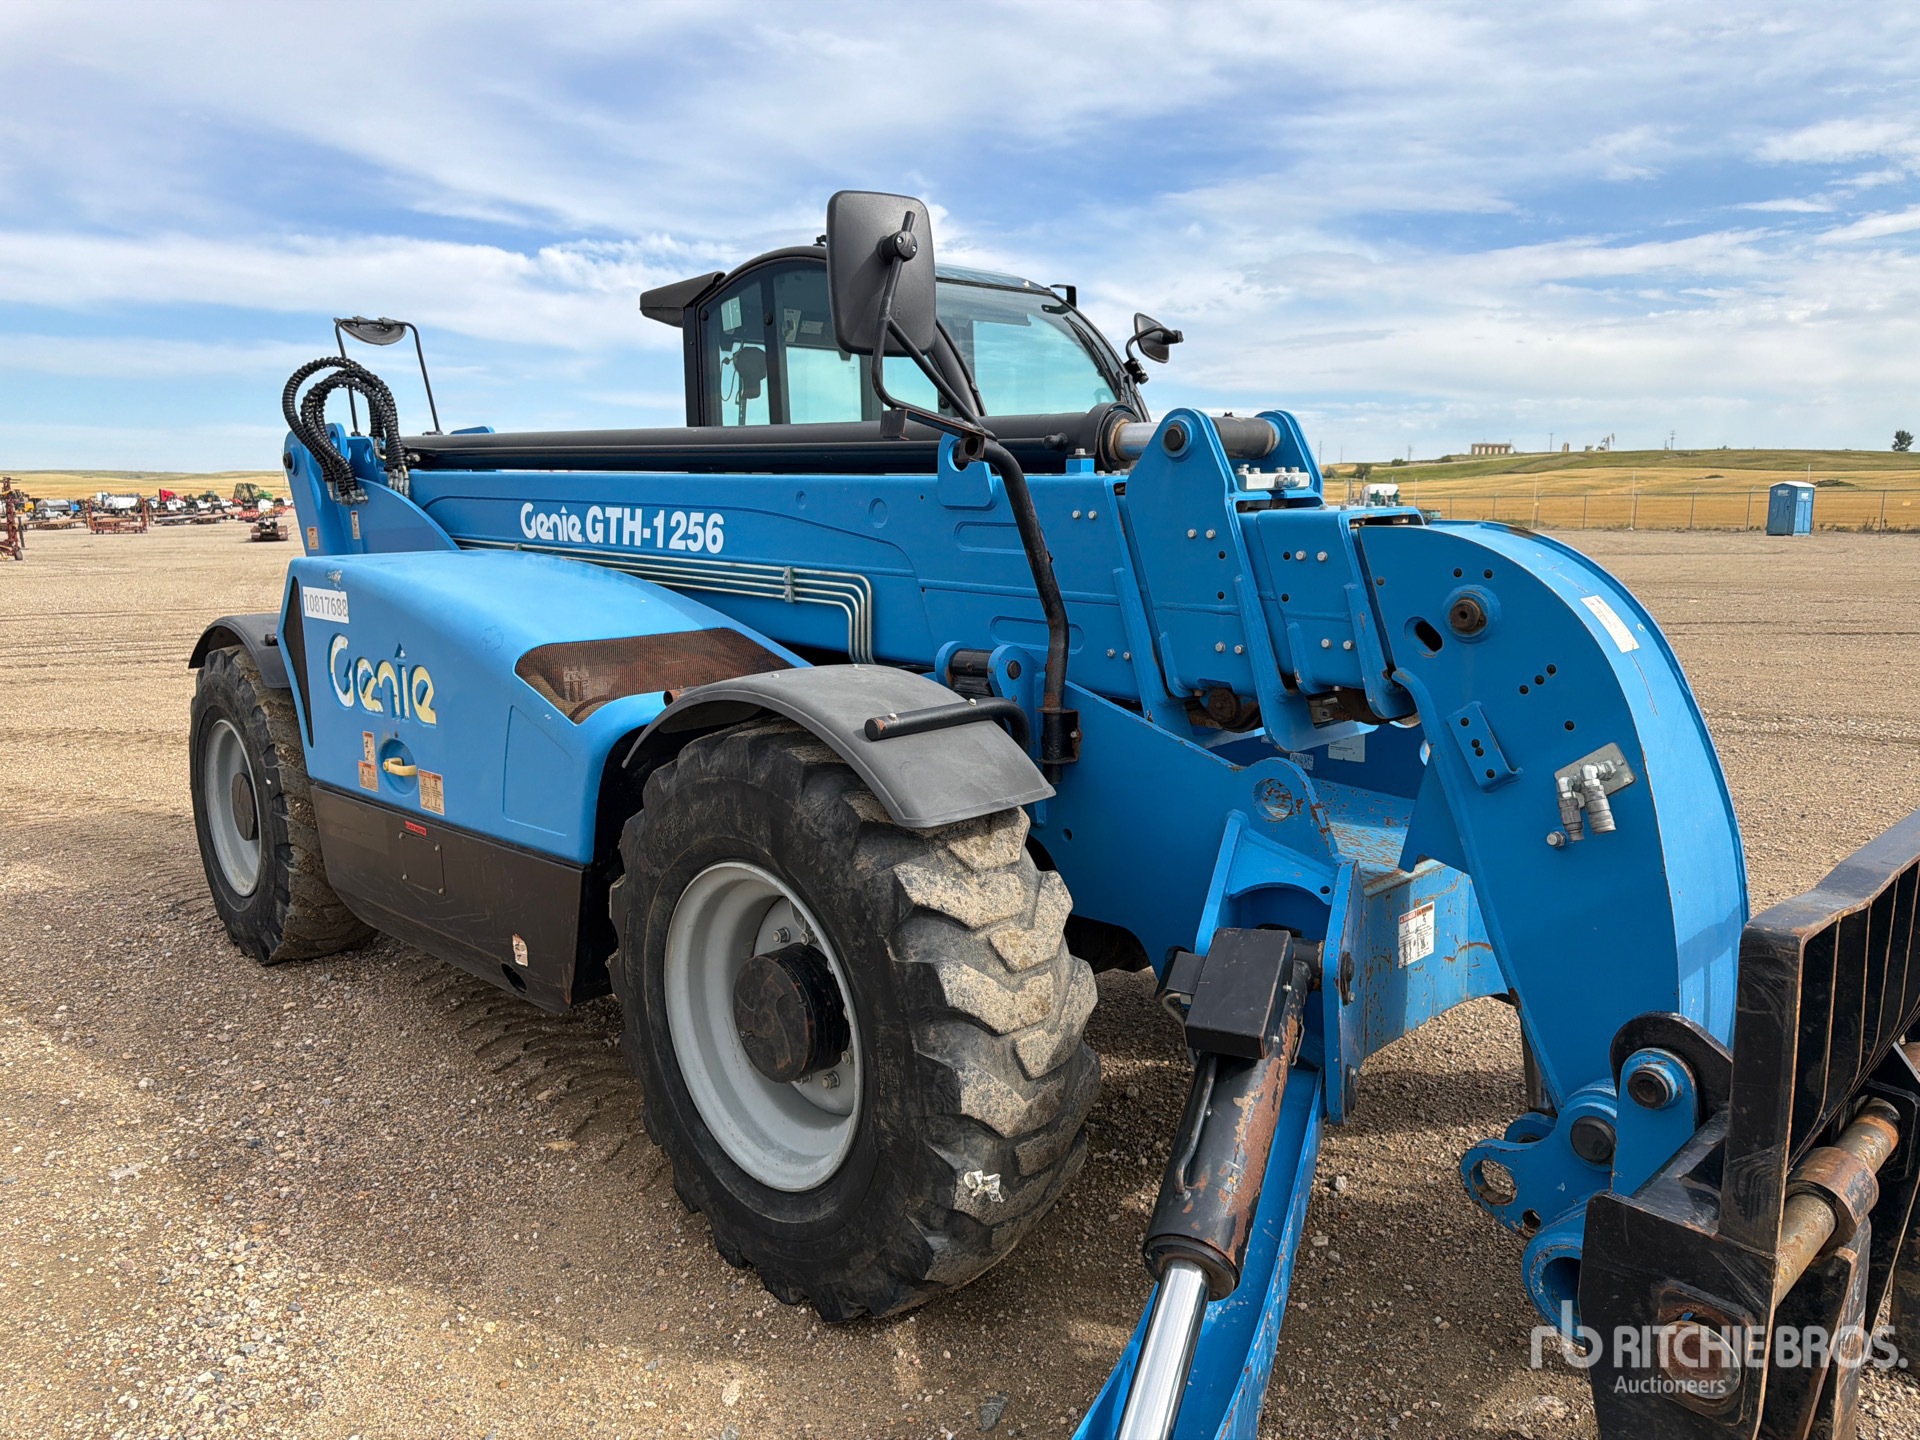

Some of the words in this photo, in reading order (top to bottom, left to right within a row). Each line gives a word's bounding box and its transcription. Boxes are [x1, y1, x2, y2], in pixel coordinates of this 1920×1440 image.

[520, 502, 583, 543] Genie
[586, 505, 725, 554] GTH-1256
[304, 594, 349, 618] 10817688
[328, 632, 437, 726] Genie
